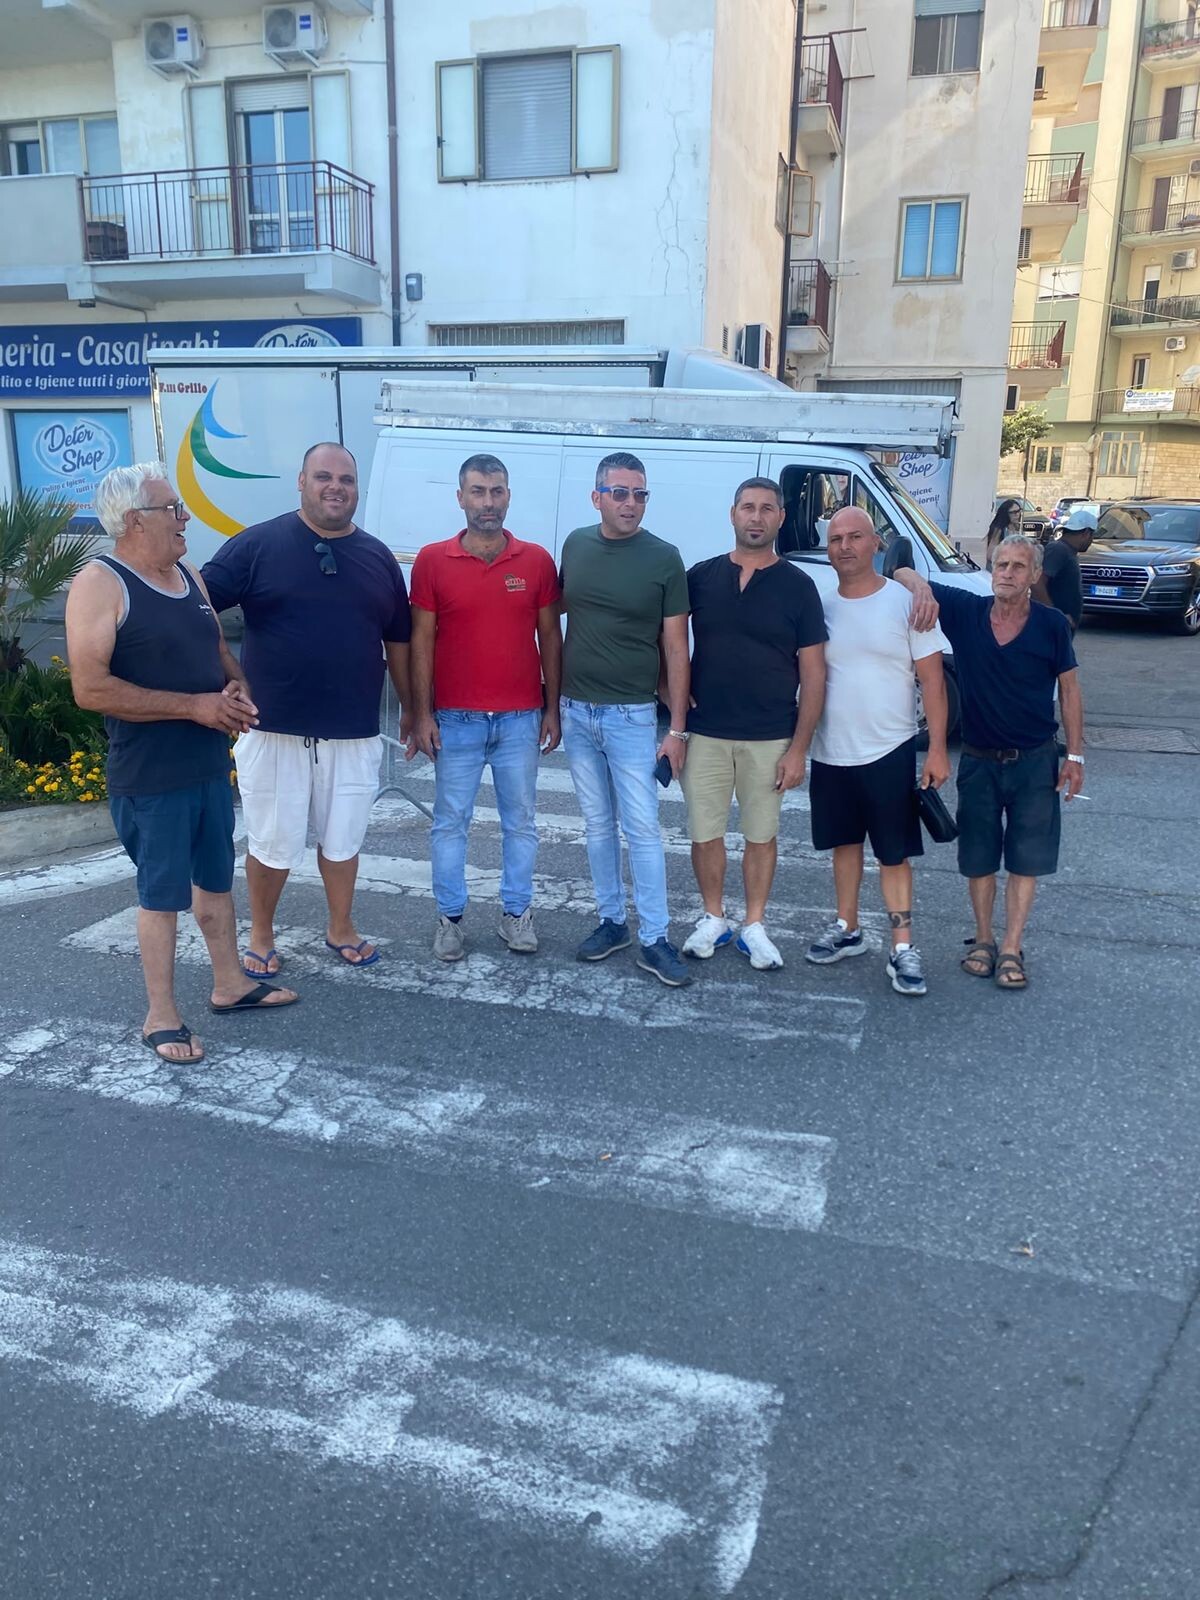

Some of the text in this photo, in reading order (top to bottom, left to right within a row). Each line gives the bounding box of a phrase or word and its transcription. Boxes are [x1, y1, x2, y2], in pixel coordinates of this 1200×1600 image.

[0, 334, 55, 367] eria
[0, 375, 22, 388] lito
[25, 377, 32, 388] e
[35, 374, 75, 391] Igiene
[78, 374, 107, 388] tutti
[177, 382, 208, 394] Grillo
[43, 424, 94, 453] Deter
[61, 448, 105, 473] Shop
[898, 462, 934, 478] Shop
[909, 487, 933, 497] giene
[918, 494, 940, 505] iorni!
